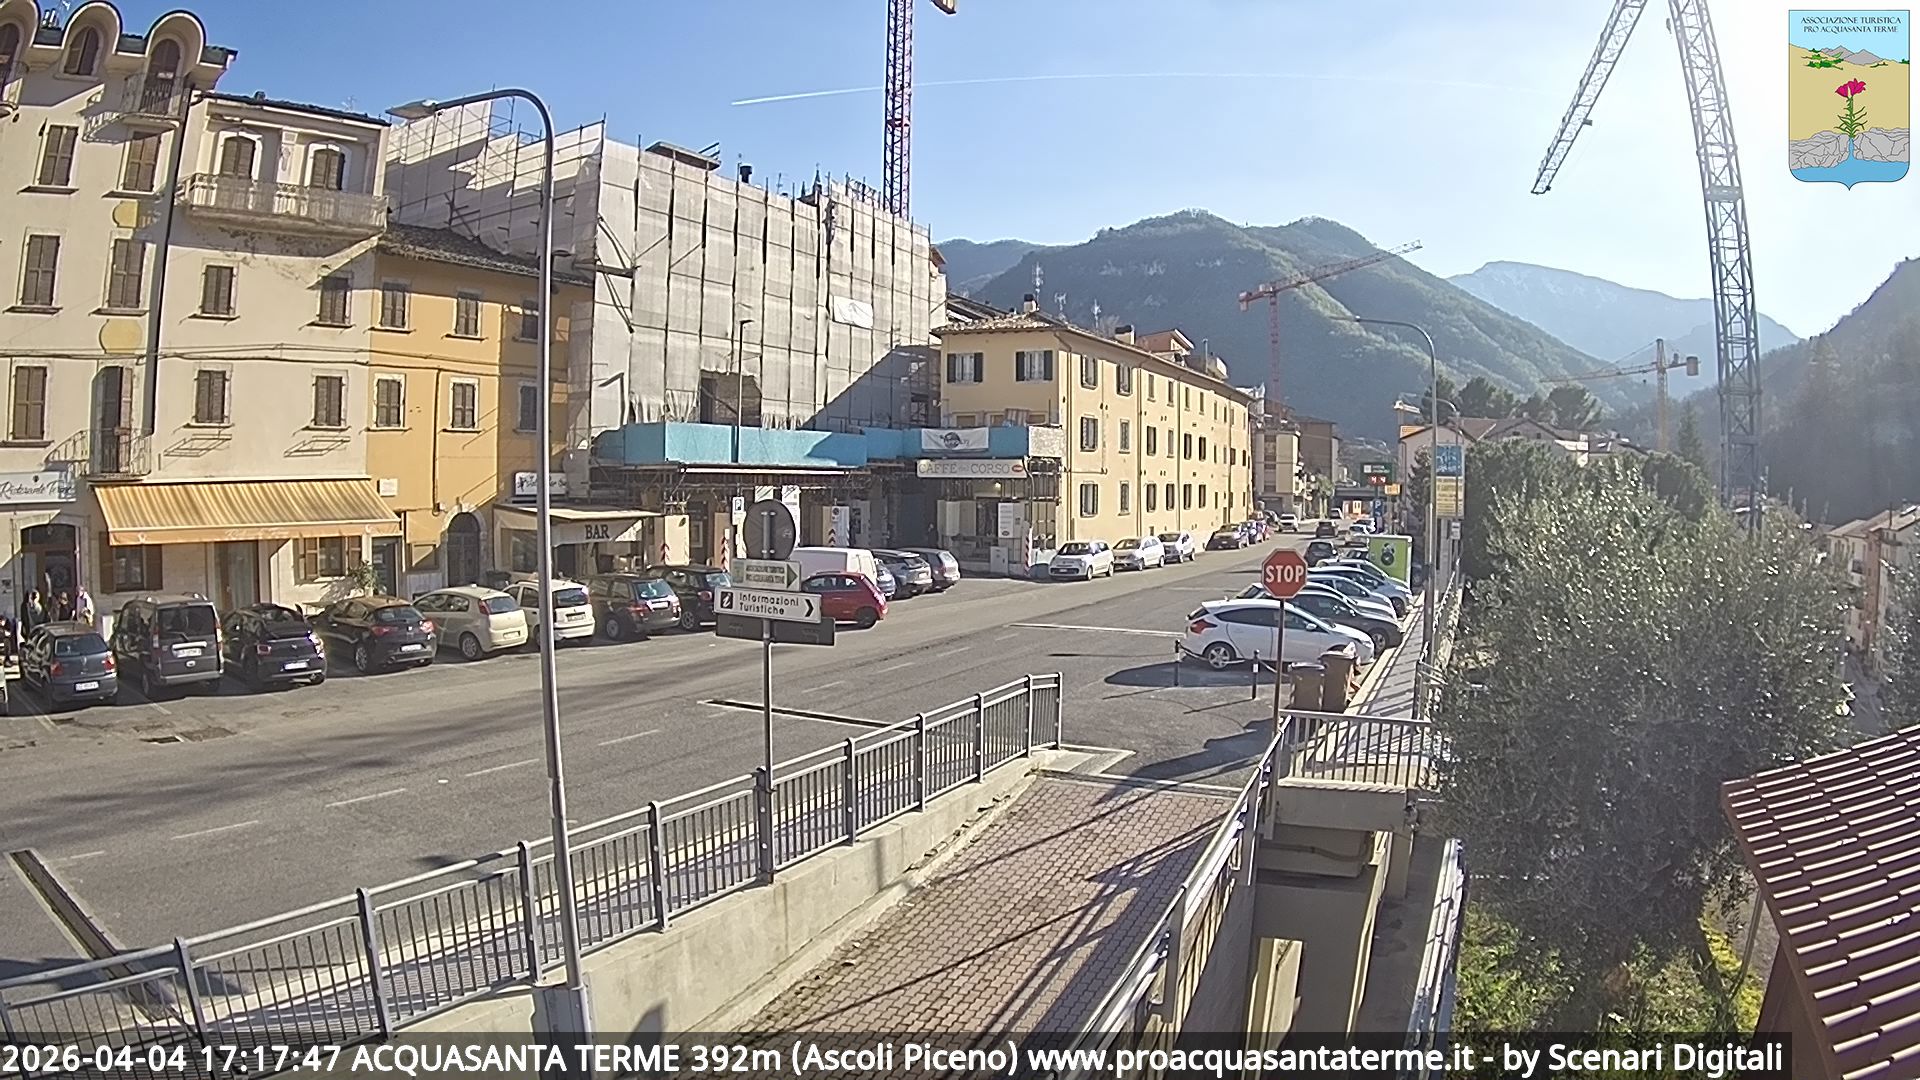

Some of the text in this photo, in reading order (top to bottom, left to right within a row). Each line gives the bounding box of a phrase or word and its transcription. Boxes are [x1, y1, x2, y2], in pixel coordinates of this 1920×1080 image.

[970, 463, 1010, 474] CORSO
[585, 524, 609, 539] BAR
[1265, 564, 1305, 583] STOP
[739, 593, 799, 606] Informazioni
[739, 602, 785, 615] Turistiche
